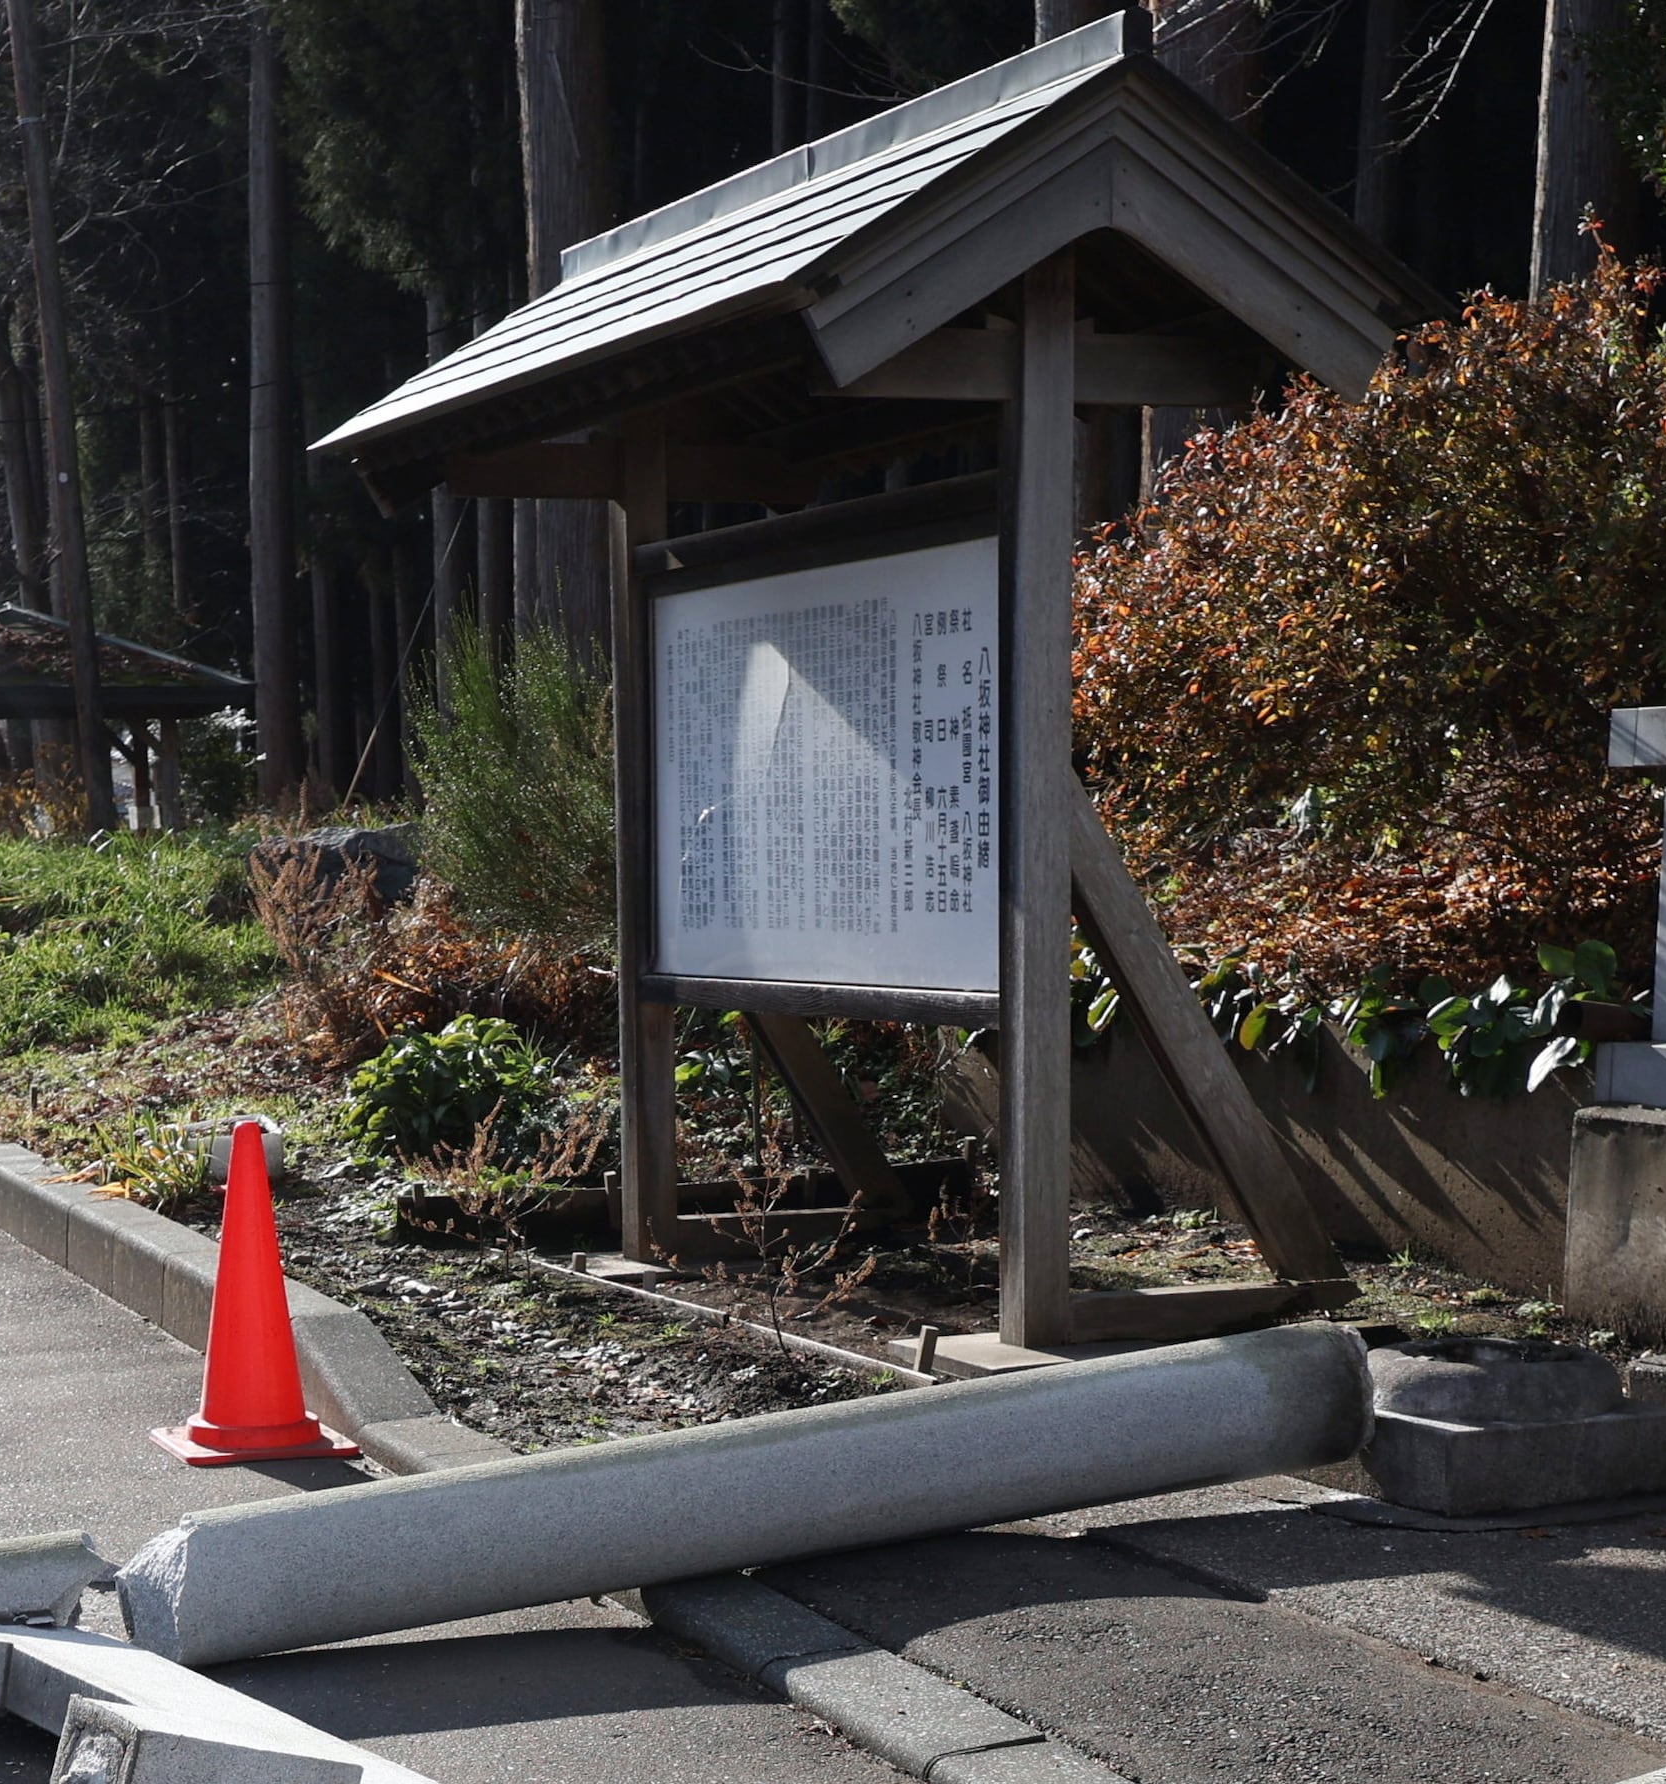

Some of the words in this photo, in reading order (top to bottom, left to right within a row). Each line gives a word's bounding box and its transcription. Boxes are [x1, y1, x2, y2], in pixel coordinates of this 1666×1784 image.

[978, 646, 991, 868] 八坂神社御由緒
[937, 785, 947, 913] 六月十五日
